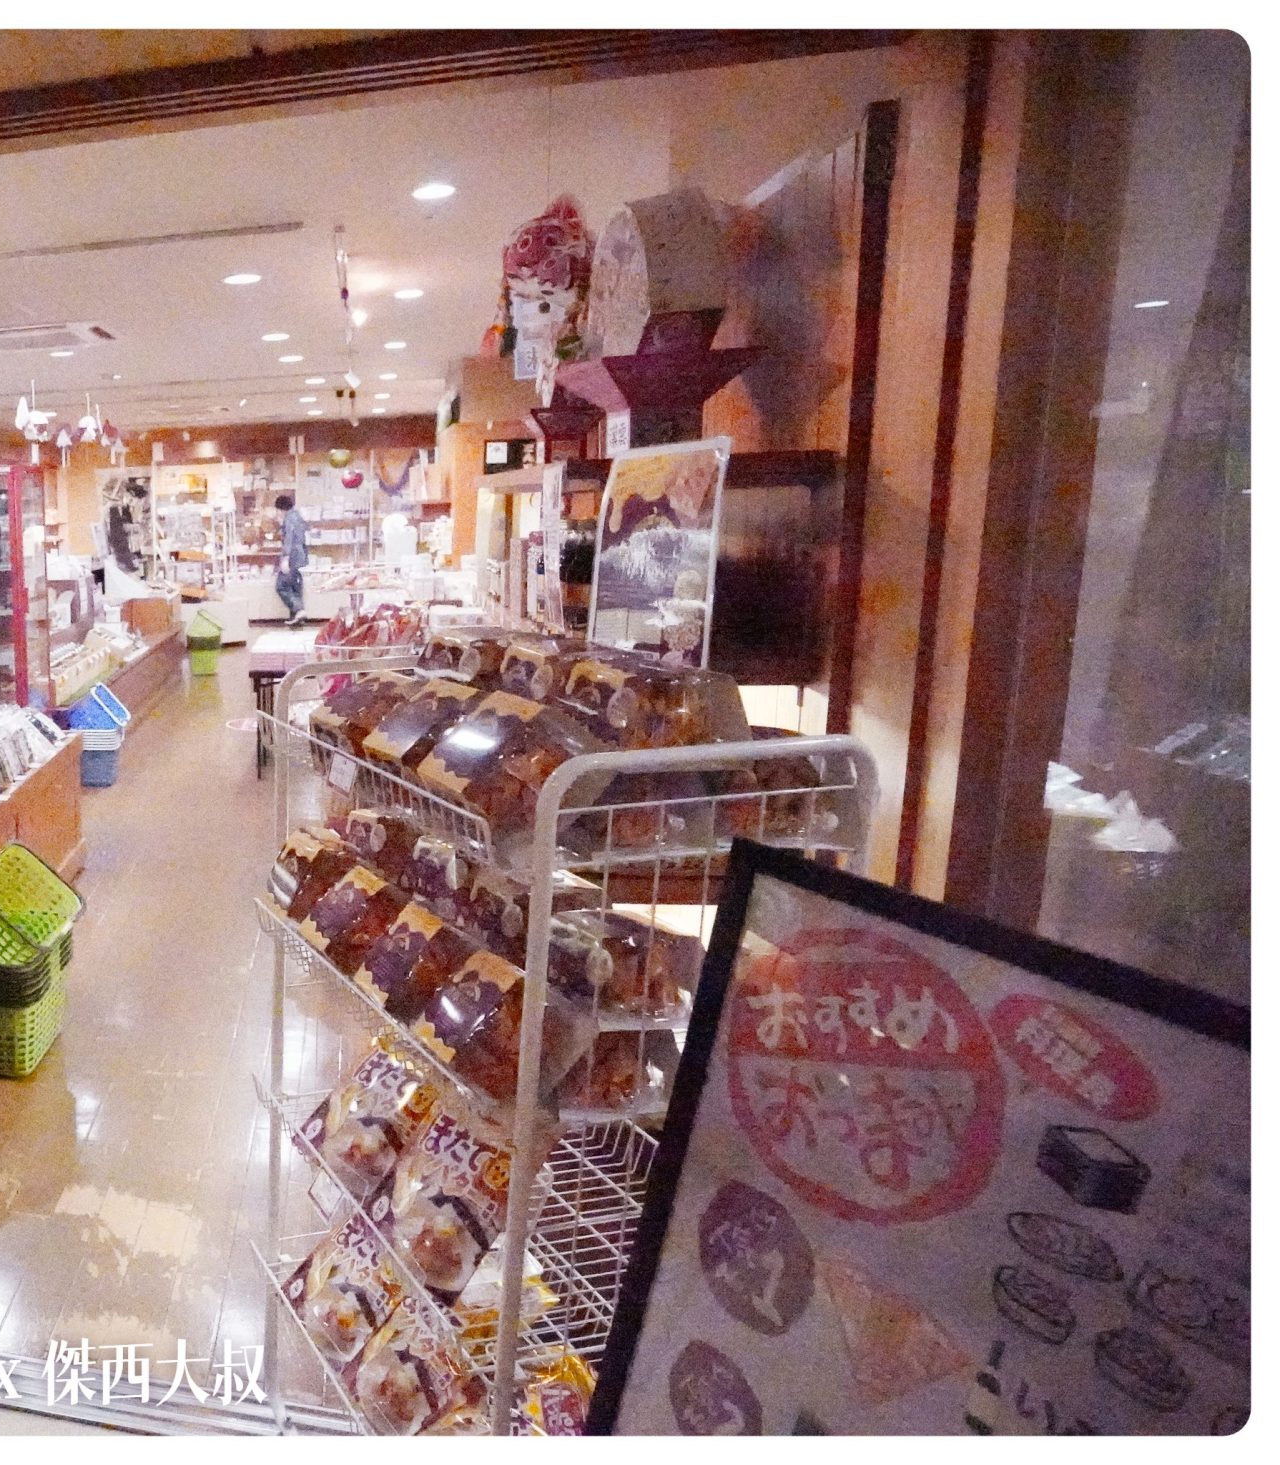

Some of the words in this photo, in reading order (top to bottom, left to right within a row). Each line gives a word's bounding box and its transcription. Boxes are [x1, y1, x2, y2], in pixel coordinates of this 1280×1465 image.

[746, 976, 960, 1054] おすすめ
[424, 1113, 499, 1173] ほたて
